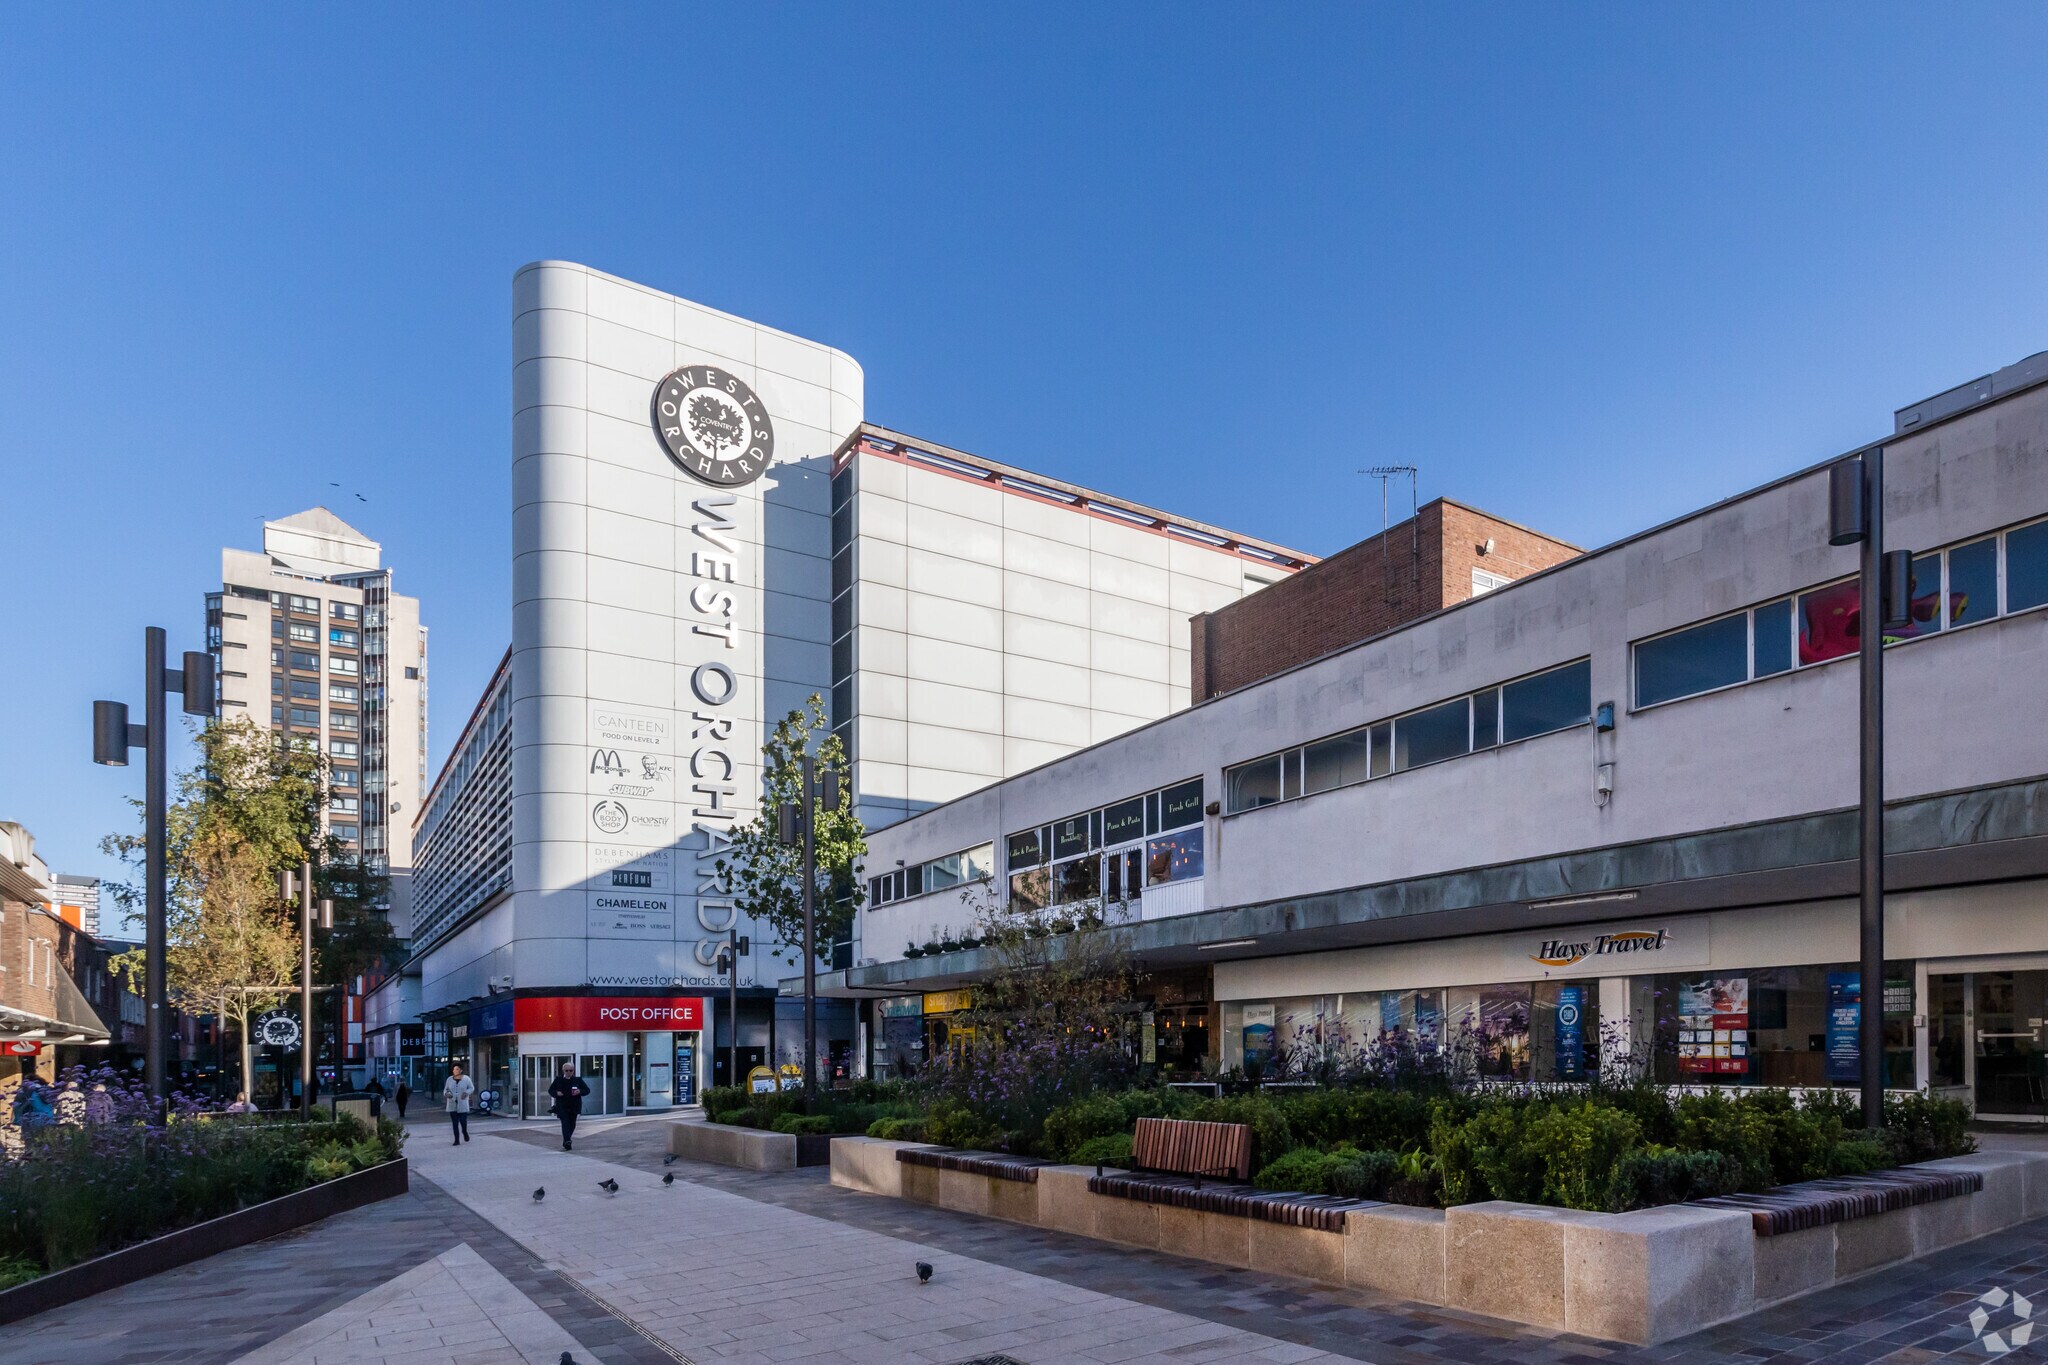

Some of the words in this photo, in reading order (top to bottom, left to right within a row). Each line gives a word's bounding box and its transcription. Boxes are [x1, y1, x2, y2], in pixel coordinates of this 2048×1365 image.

[675, 370, 756, 407] WEST
[700, 416, 733, 432] COVENTRY
[661, 401, 769, 479] ORCHARDS
[692, 495, 739, 649] WEST
[598, 715, 664, 733] CANTEEN
[602, 732, 621, 740] FOOD
[634, 736, 654, 744] LEVEL
[609, 784, 654, 796] SUBWAY
[1169, 801, 1184, 813] Fresh
[1185, 796, 1199, 808] Grill
[691, 661, 738, 967] ORCHARDS
[1121, 818, 1126, 827] &
[595, 848, 669, 860] DEBENHAMS
[613, 872, 651, 885] PERFUME
[596, 898, 667, 910] CHAMELEON
[1539, 940, 1589, 962] Hays
[1594, 929, 1664, 955] Travel
[588, 974, 752, 986] www.westorchards.co.uk
[258, 1010, 298, 1024] WEST
[600, 1008, 638, 1020] POST
[642, 1007, 692, 1020] OFFICE
